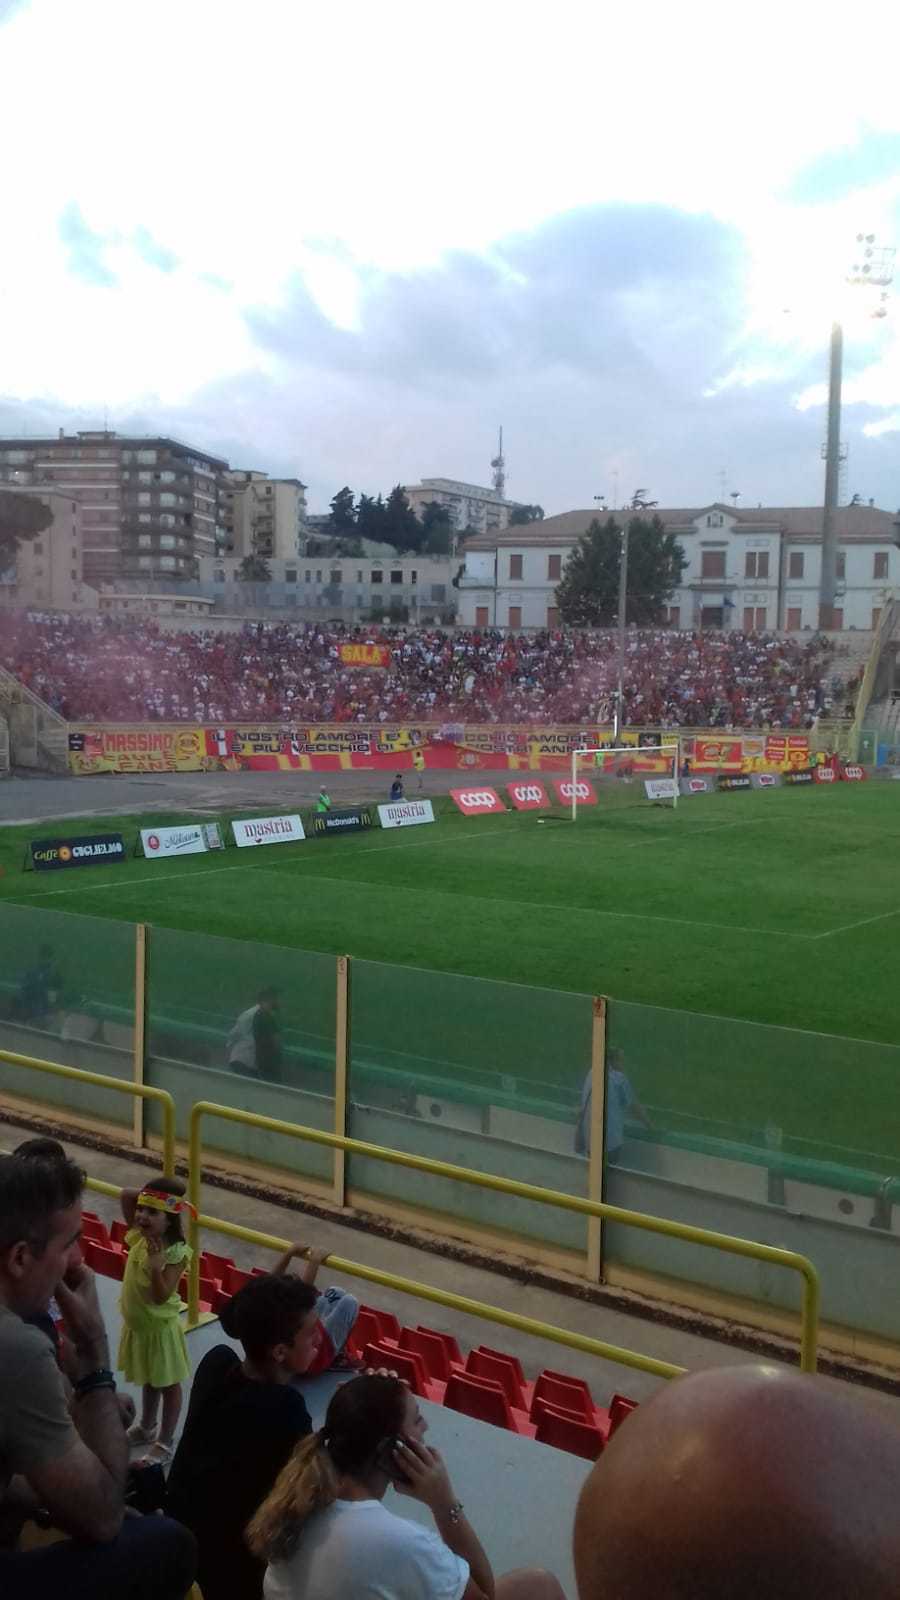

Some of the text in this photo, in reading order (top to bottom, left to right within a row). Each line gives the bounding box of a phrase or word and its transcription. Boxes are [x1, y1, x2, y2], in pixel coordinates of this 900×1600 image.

[104, 733, 175, 751] MASSIMO
[236, 732, 306, 742] NOSTRO
[290, 743, 370, 753] VECCHIO
[118, 760, 177, 770] FANS
[514, 785, 543, 803] coop
[559, 782, 590, 799] coop
[459, 792, 496, 808] coop
[387, 805, 426, 821] mastria
[244, 818, 293, 839] mastria
